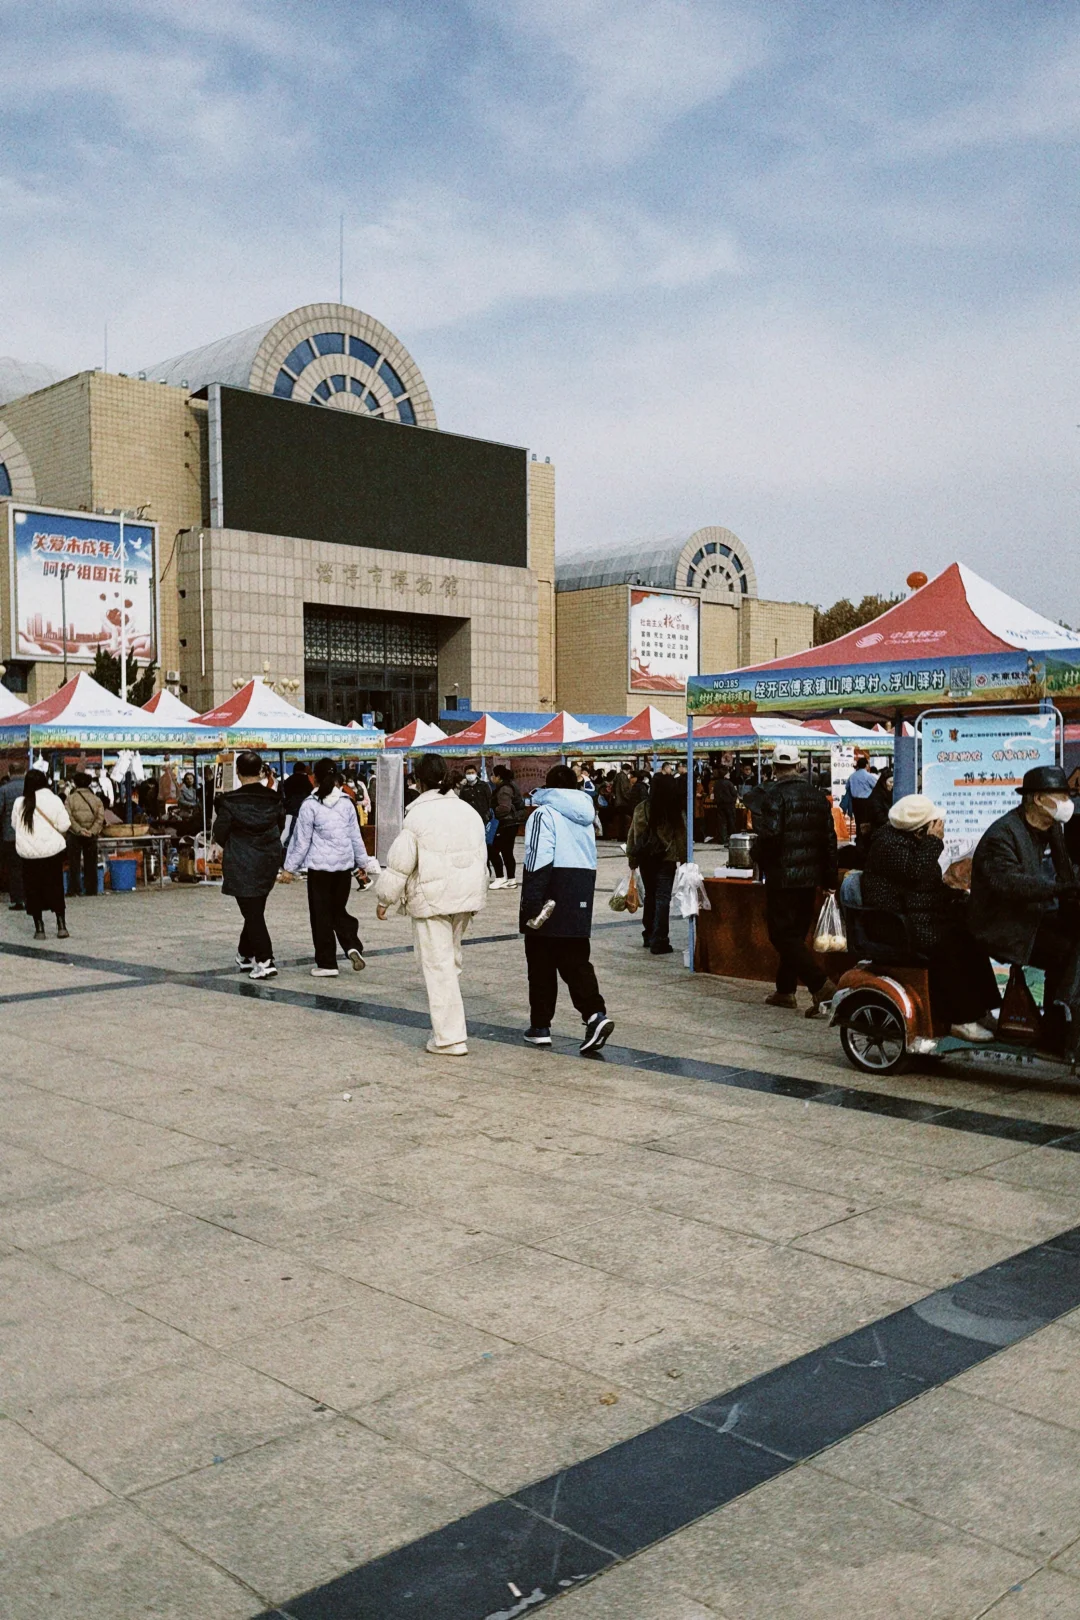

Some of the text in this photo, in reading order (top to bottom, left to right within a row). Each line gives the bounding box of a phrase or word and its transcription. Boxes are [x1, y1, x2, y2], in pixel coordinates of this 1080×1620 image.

[32, 532, 129, 561] 关爱未成年人
[43, 561, 138, 584] 呵护祖国花朵
[889, 630, 948, 639] 中国移动
[713, 679, 739, 689] NO.185
